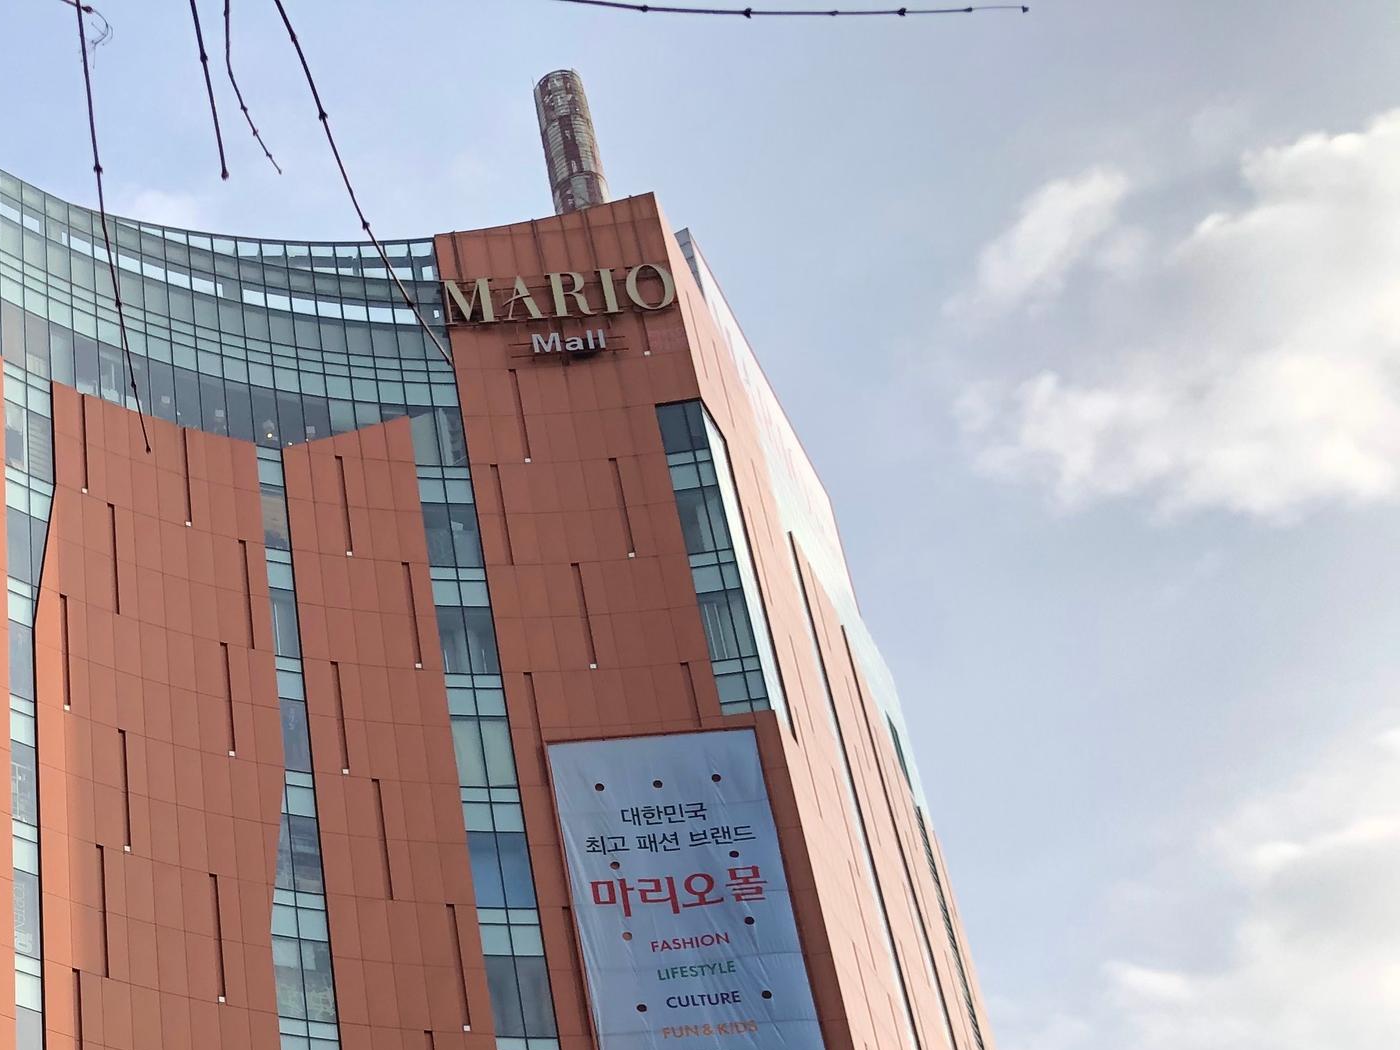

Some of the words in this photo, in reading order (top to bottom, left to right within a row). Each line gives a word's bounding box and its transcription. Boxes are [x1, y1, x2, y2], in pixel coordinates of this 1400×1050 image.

[443, 263, 677, 326] MARIO
[531, 329, 607, 353] Mall
[620, 801, 707, 828] 대한민국
[585, 831, 630, 857] 최고
[637, 828, 681, 853] 패션
[688, 823, 756, 848] 브랜드
[590, 864, 768, 918] 마리오몰
[650, 931, 730, 953] FASHION
[657, 960, 737, 981] LIFESTYLE
[666, 990, 741, 1009] CULTURE
[662, 1024, 699, 1039] FUN
[702, 1023, 713, 1036] &
[717, 1019, 758, 1036] KIDS
